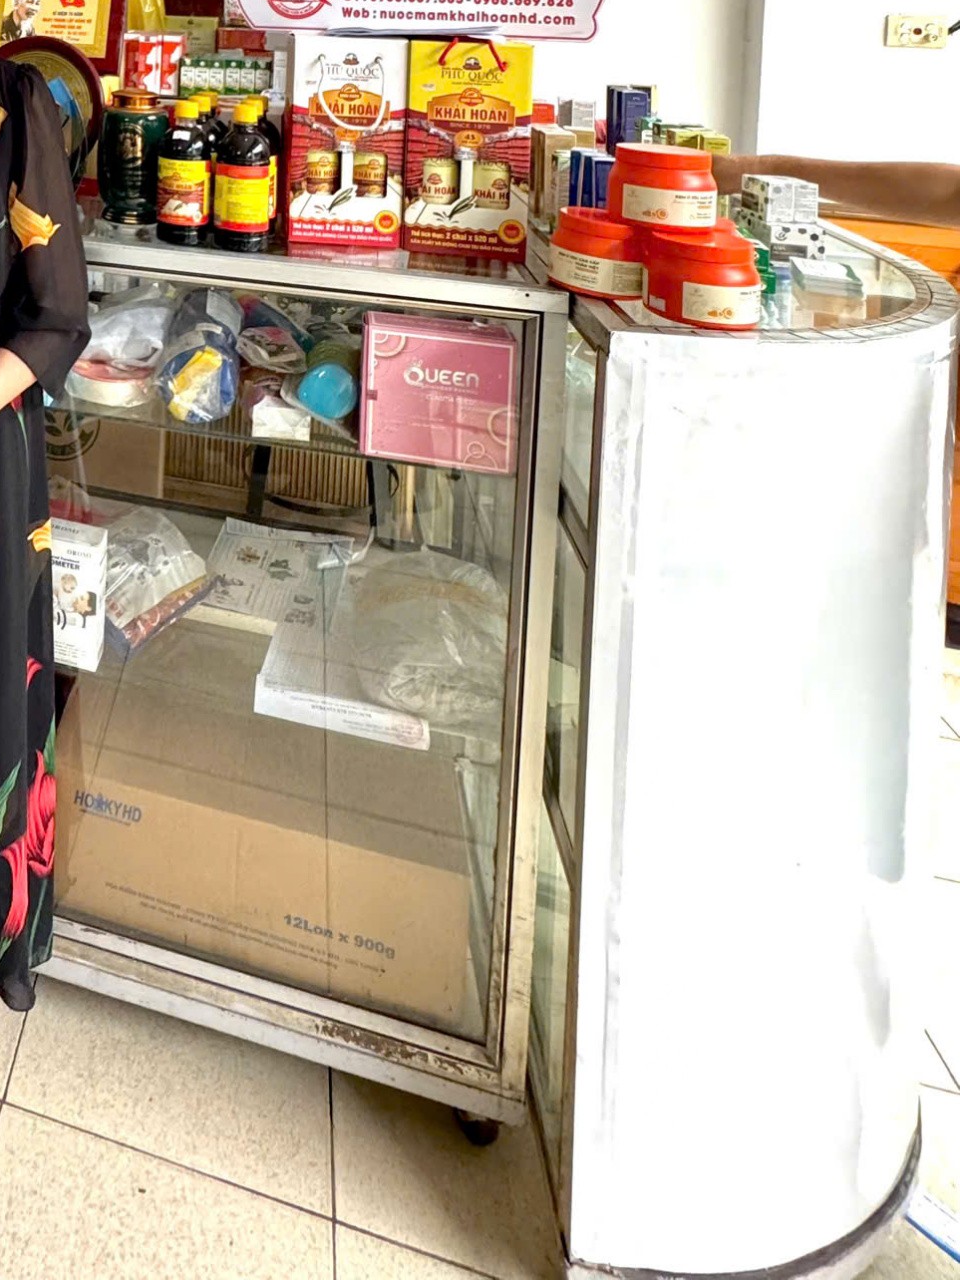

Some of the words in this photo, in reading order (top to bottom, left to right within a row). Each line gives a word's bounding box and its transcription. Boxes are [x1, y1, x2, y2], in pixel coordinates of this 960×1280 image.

[435, 105, 466, 120] KHẢI
[470, 107, 508, 122] HOÀN
[283, 914, 334, 939] 12Lon
[338, 933, 349, 943] x
[353, 935, 396, 960] 900g
